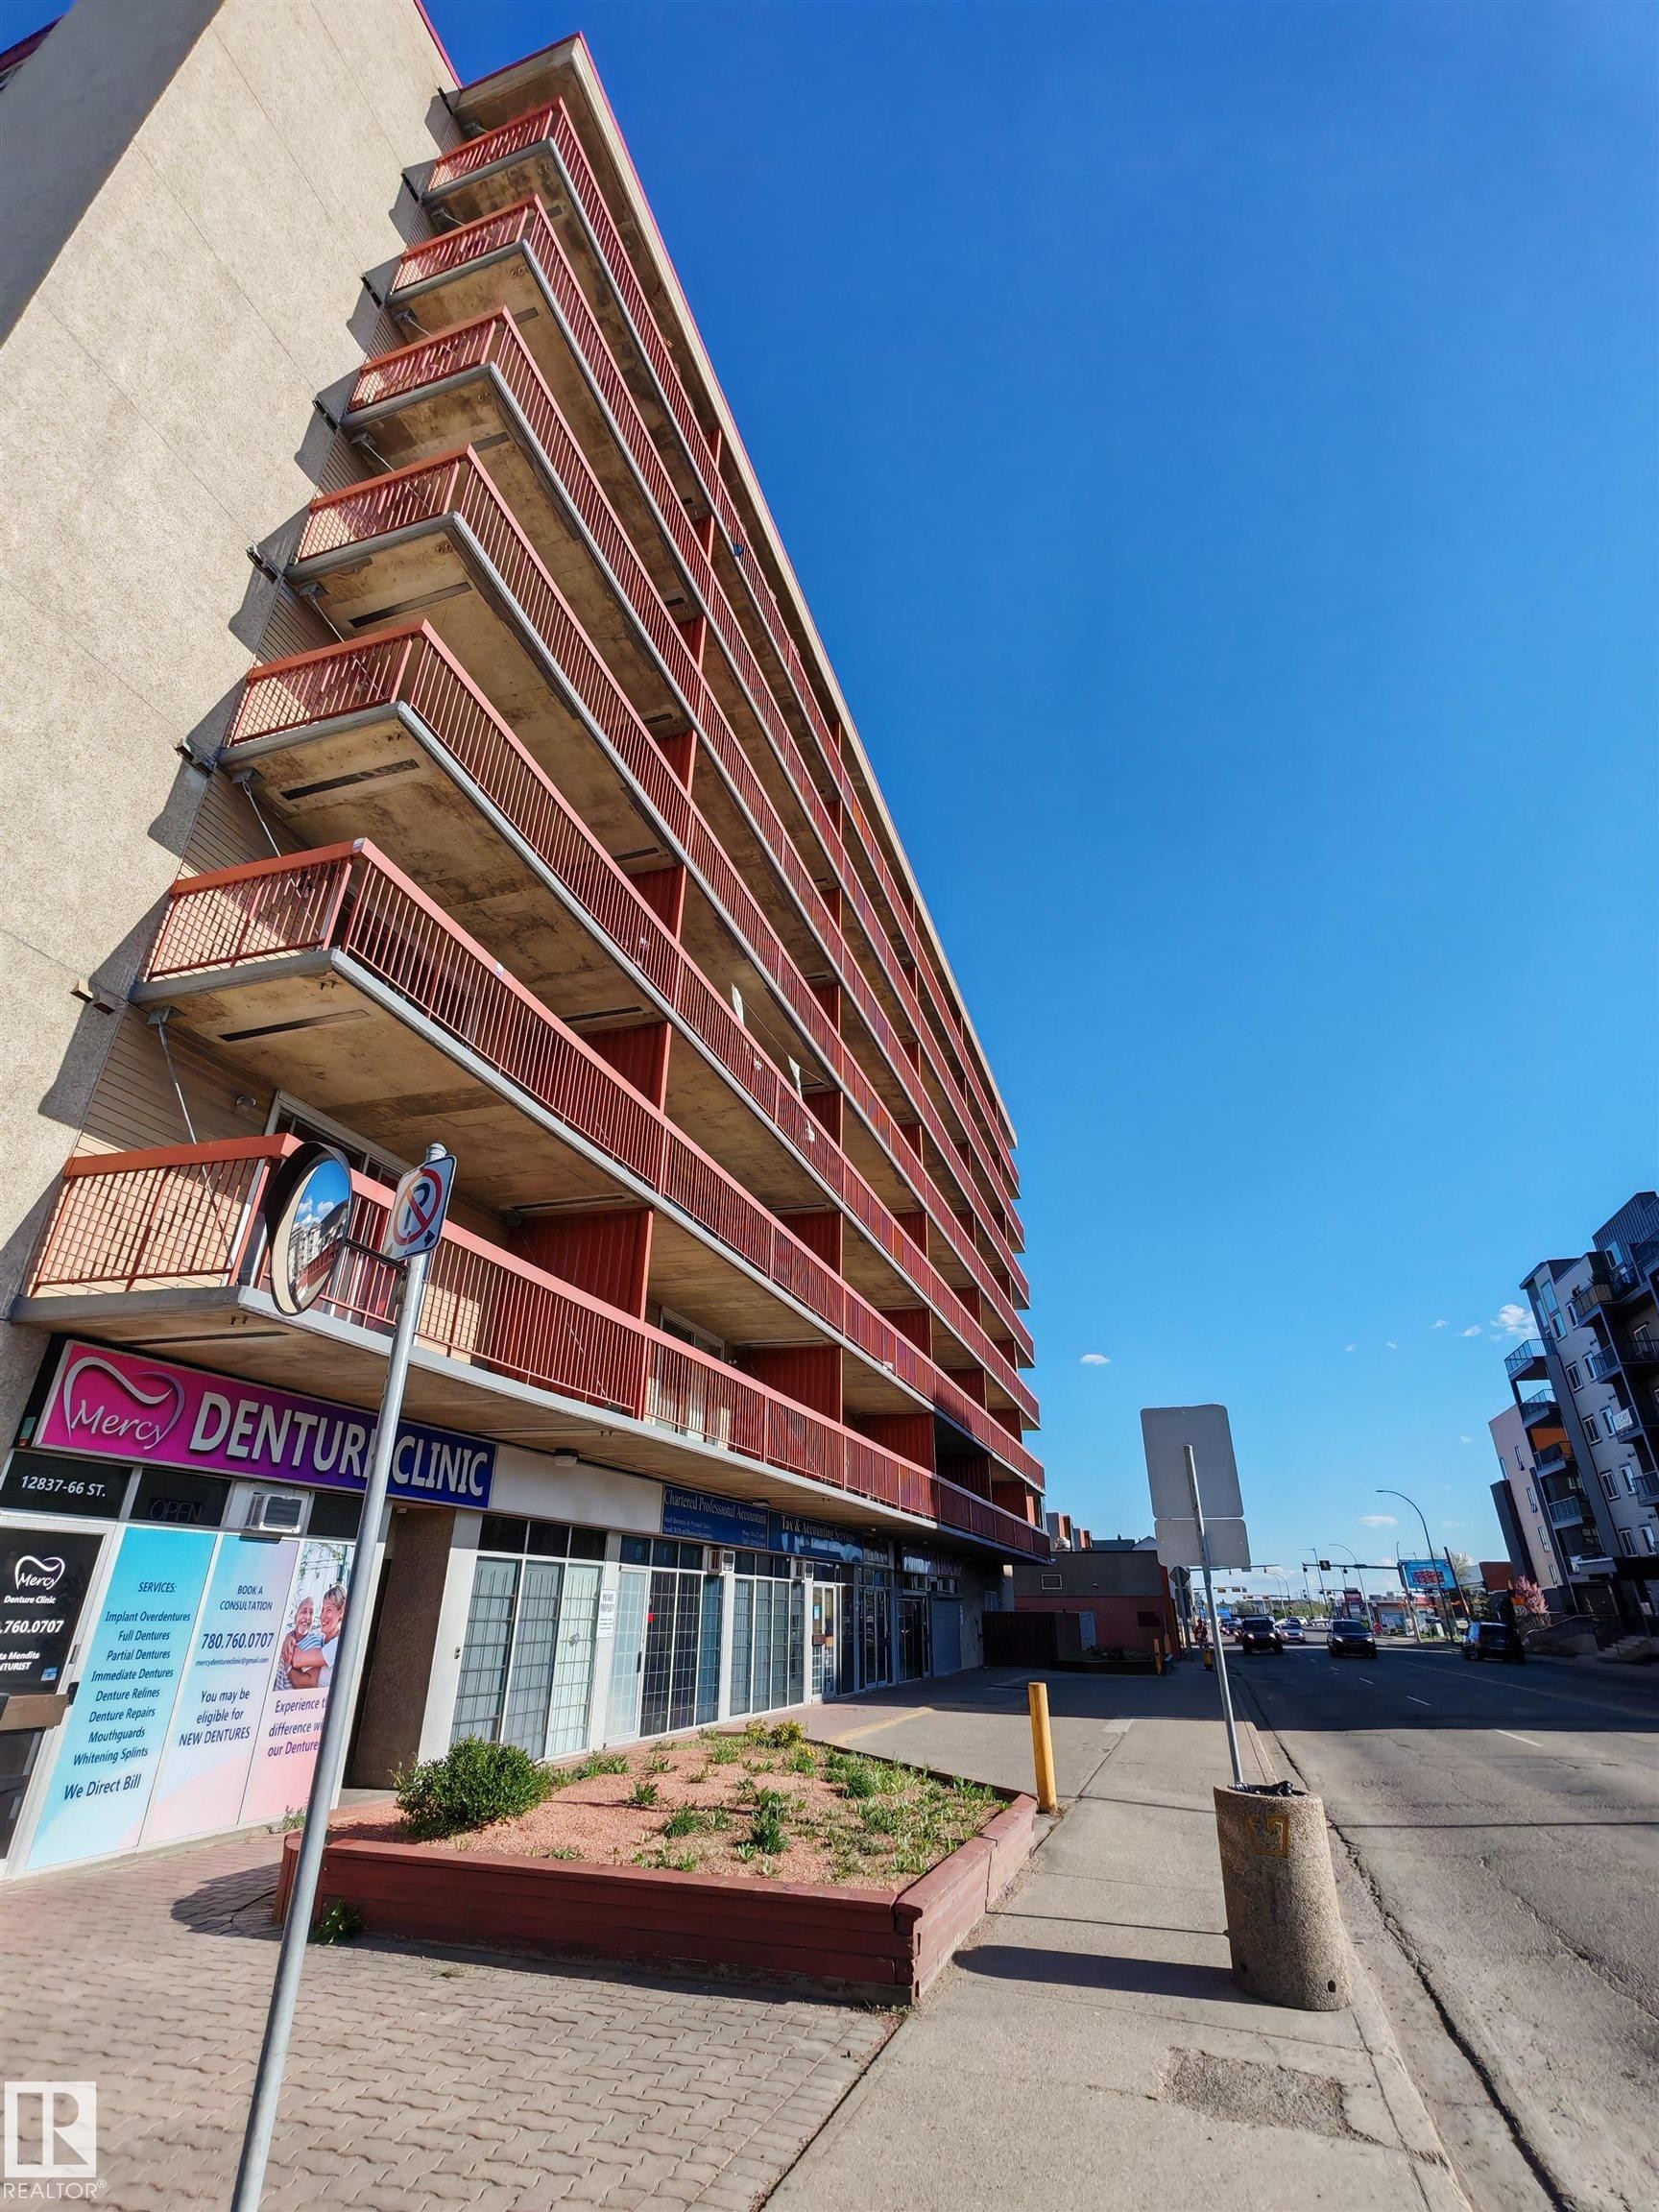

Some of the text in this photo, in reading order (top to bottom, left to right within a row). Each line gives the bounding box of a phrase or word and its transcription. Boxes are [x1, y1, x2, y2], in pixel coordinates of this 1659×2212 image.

[70, 1399, 165, 1451] Mercy
[393, 1435, 488, 1497] CLINIC
[20, 1476, 107, 1497] 12837-66 ST.
[150, 1500, 204, 1523] OPEN
[663, 1489, 698, 1510] Chartered
[699, 1496, 735, 1518] Professional
[781, 1515, 793, 1531] Tax
[794, 1518, 801, 1533] &
[19, 1573, 55, 1590] Mercy
[138, 1581, 177, 1594] SERVICES:
[237, 1585, 264, 1596] BOOK A
[220, 1600, 274, 1611] CONSULTATION
[105, 1611, 191, 1624] Implant Overdentures
[118, 1630, 171, 1641] Full Dentures
[201, 1632, 275, 1650] 780.760.0707
[106, 1649, 171, 1662] Partial Dentures
[91, 1669, 174, 1682] Immediate Dentures
[96, 1688, 160, 1702] Denture Relines
[200, 1688, 251, 1705] You may be
[89, 1706, 156, 1723] Denture Repairs
[275, 1697, 320, 1716] Experience
[196, 1709, 245, 1726] eligible for
[88, 1726, 146, 1743] Mouthguards
[179, 1726, 252, 1747] NEW DENTURES
[269, 1721, 312, 1737] difference
[73, 1747, 149, 1767] Whitening Splints
[268, 1745, 283, 1757] our
[64, 1773, 142, 1800] We Direct Bill
